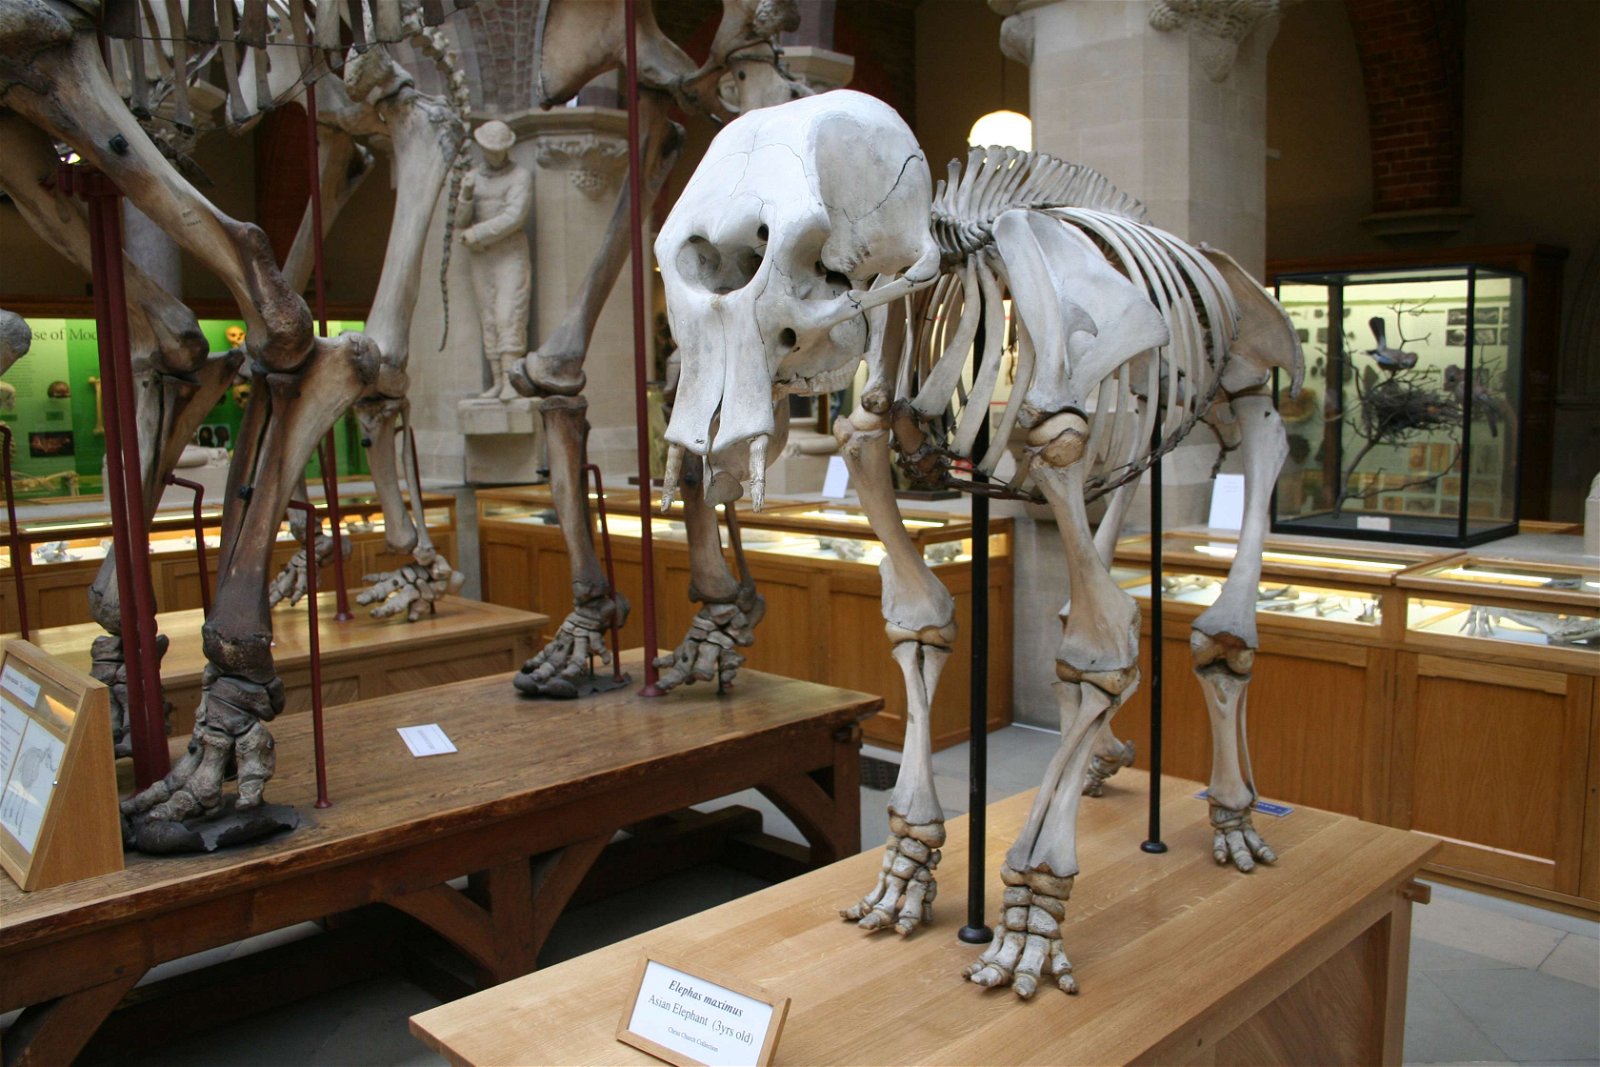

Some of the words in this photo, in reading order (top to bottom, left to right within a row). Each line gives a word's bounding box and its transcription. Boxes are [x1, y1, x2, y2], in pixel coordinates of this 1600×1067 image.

[50, 328, 65, 341] of
[668, 980, 703, 1001] Elephas
[703, 996, 744, 1017] maximus
[648, 994, 671, 1011] Asian
[672, 1003, 709, 1026] Elephant
[712, 1019, 734, 1035] (3yrs
[735, 1030, 754, 1046] old)
[681, 1032, 697, 1044] Church
[696, 1038, 719, 1053] Collection
